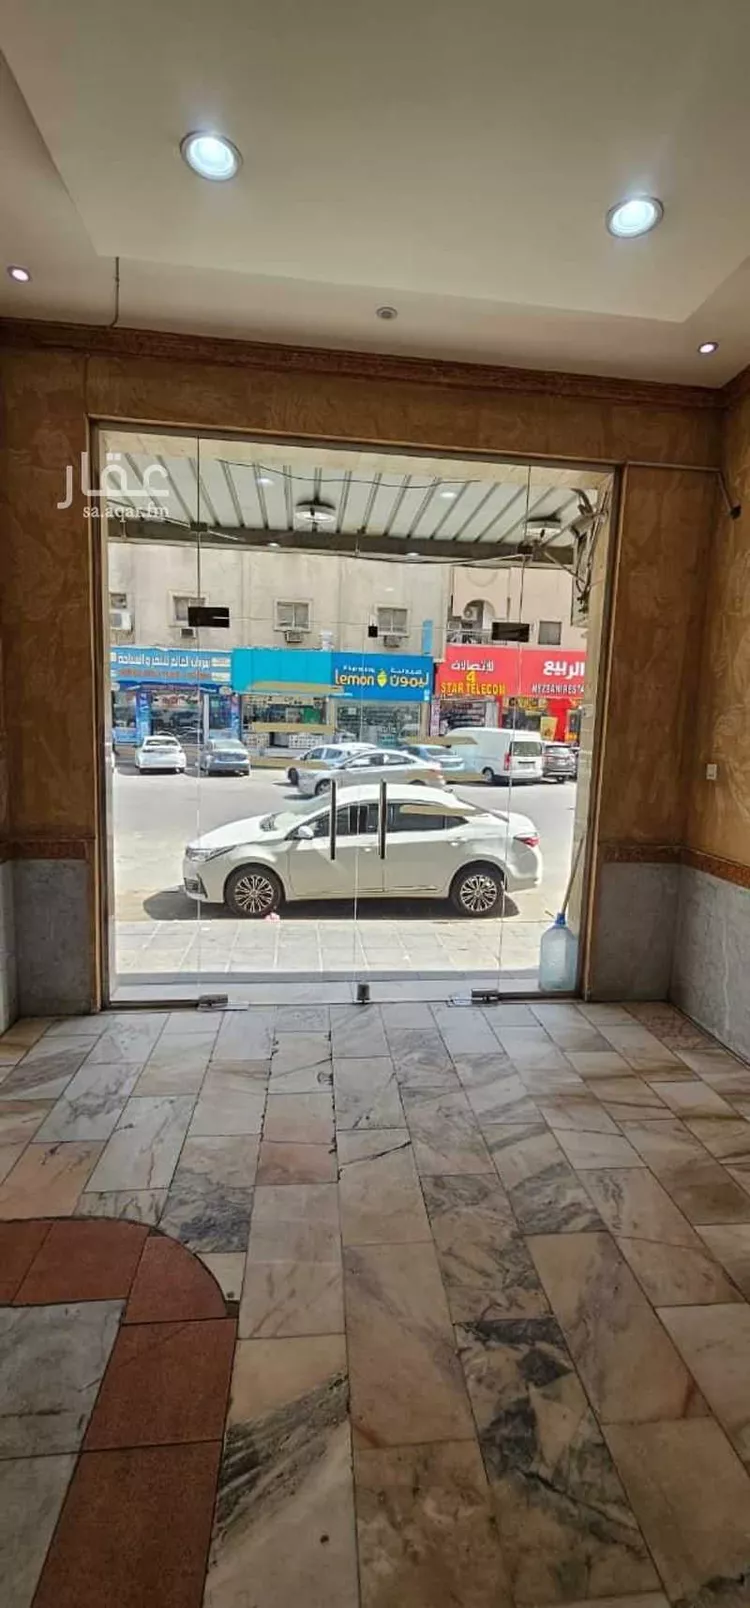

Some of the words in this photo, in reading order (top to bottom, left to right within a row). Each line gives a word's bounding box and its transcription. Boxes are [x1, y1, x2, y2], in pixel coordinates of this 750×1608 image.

[466, 670, 475, 684] 4
[543, 660, 585, 680] الربيع
[390, 671, 430, 688] ليمون
[440, 681, 464, 694] STAR
[466, 683, 506, 695] TELECOM
